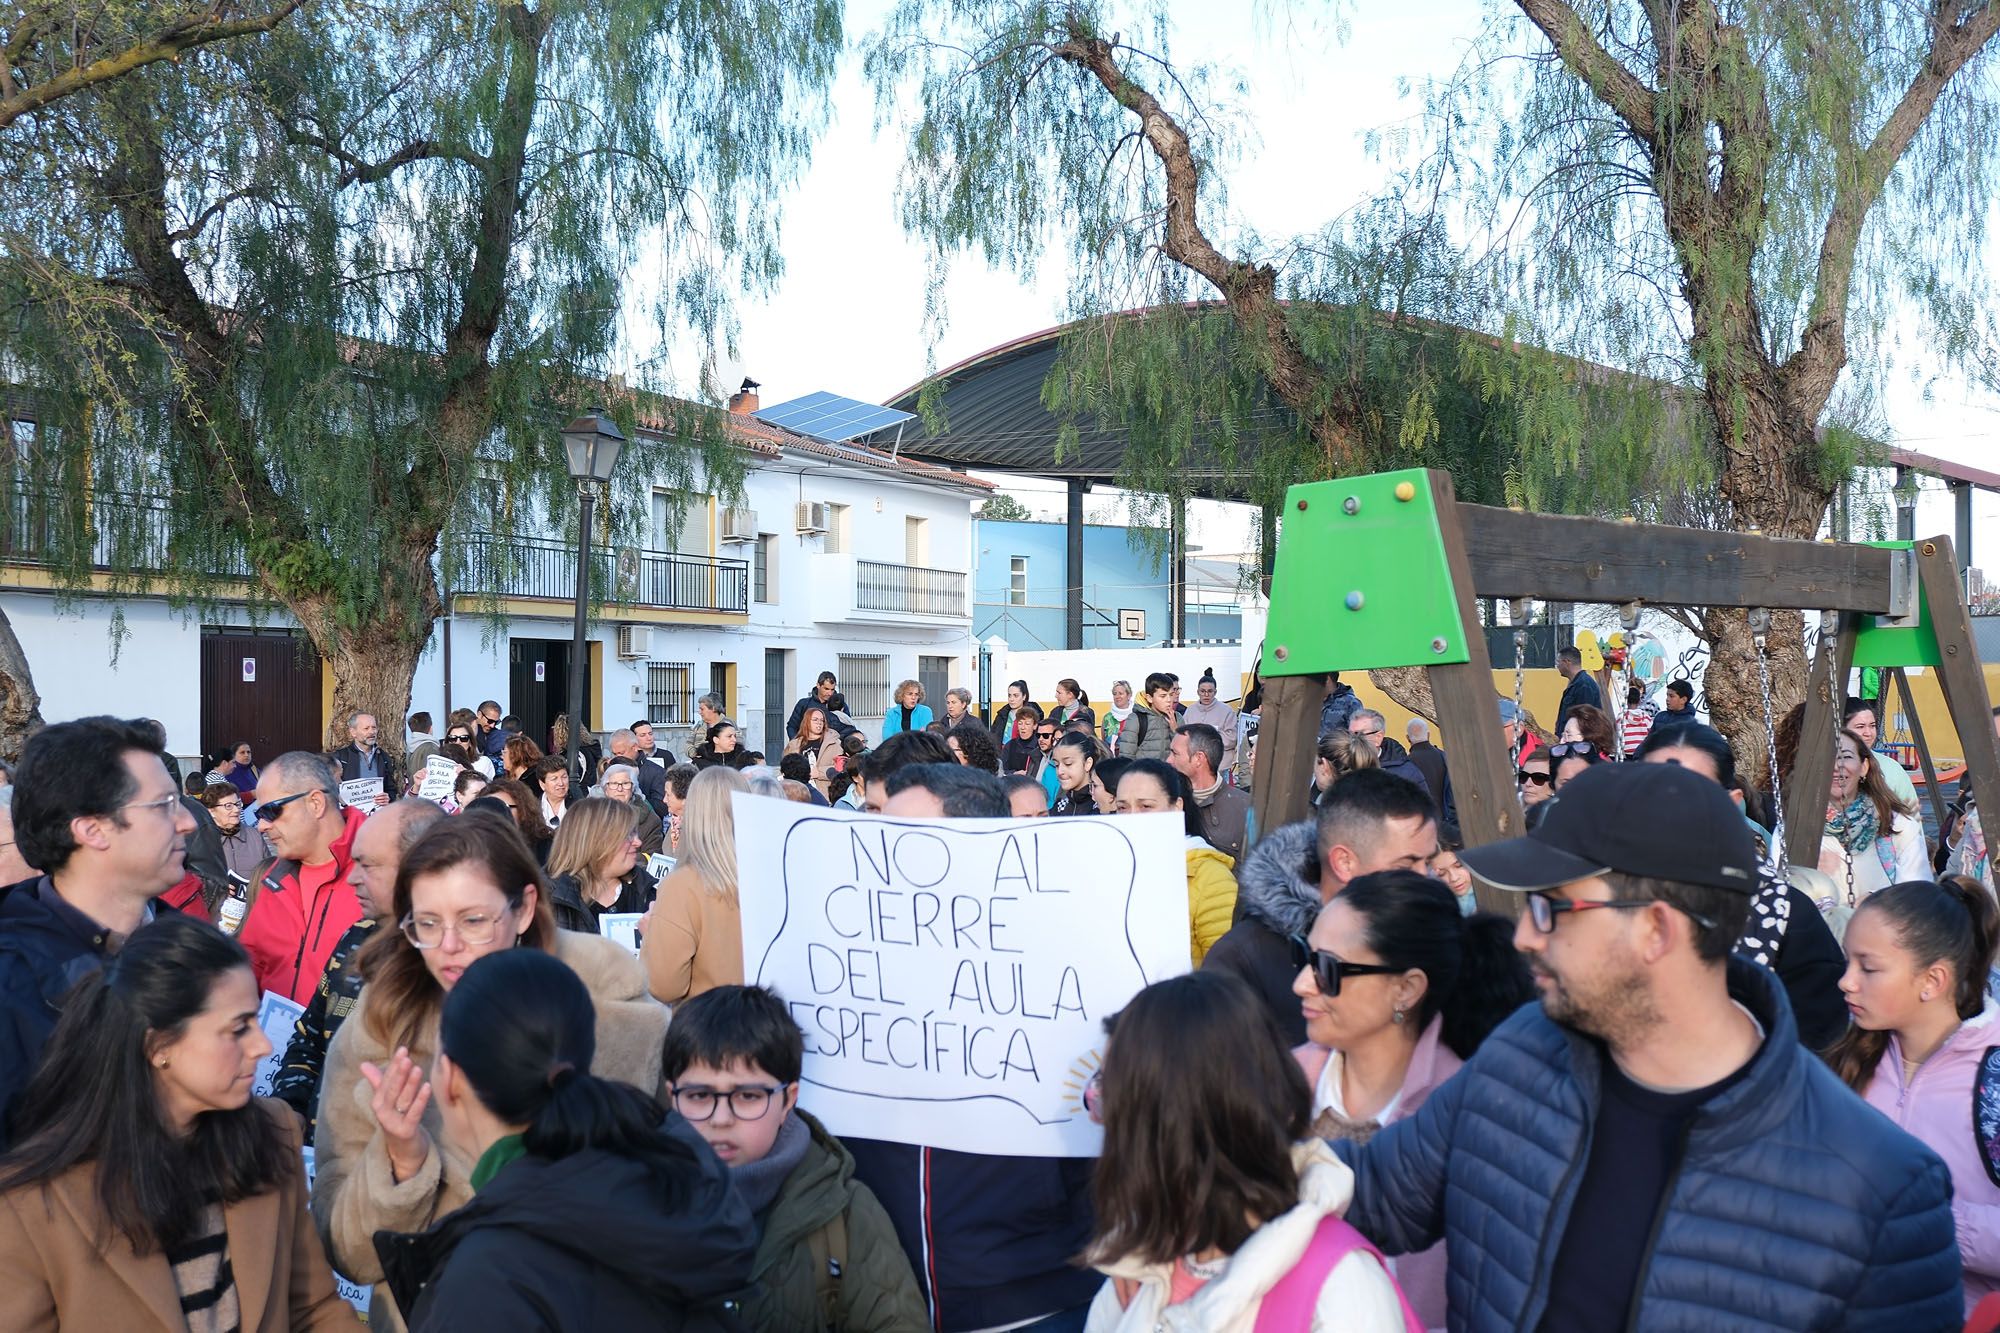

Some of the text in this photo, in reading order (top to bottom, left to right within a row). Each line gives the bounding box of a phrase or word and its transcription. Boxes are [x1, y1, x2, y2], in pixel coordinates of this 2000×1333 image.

[850, 826, 1071, 893] NO AL
[825, 885, 1025, 953] CIERRE
[808, 943, 1088, 1022] DEL AULA
[789, 1001, 1041, 1083] ESPECÍFICA
